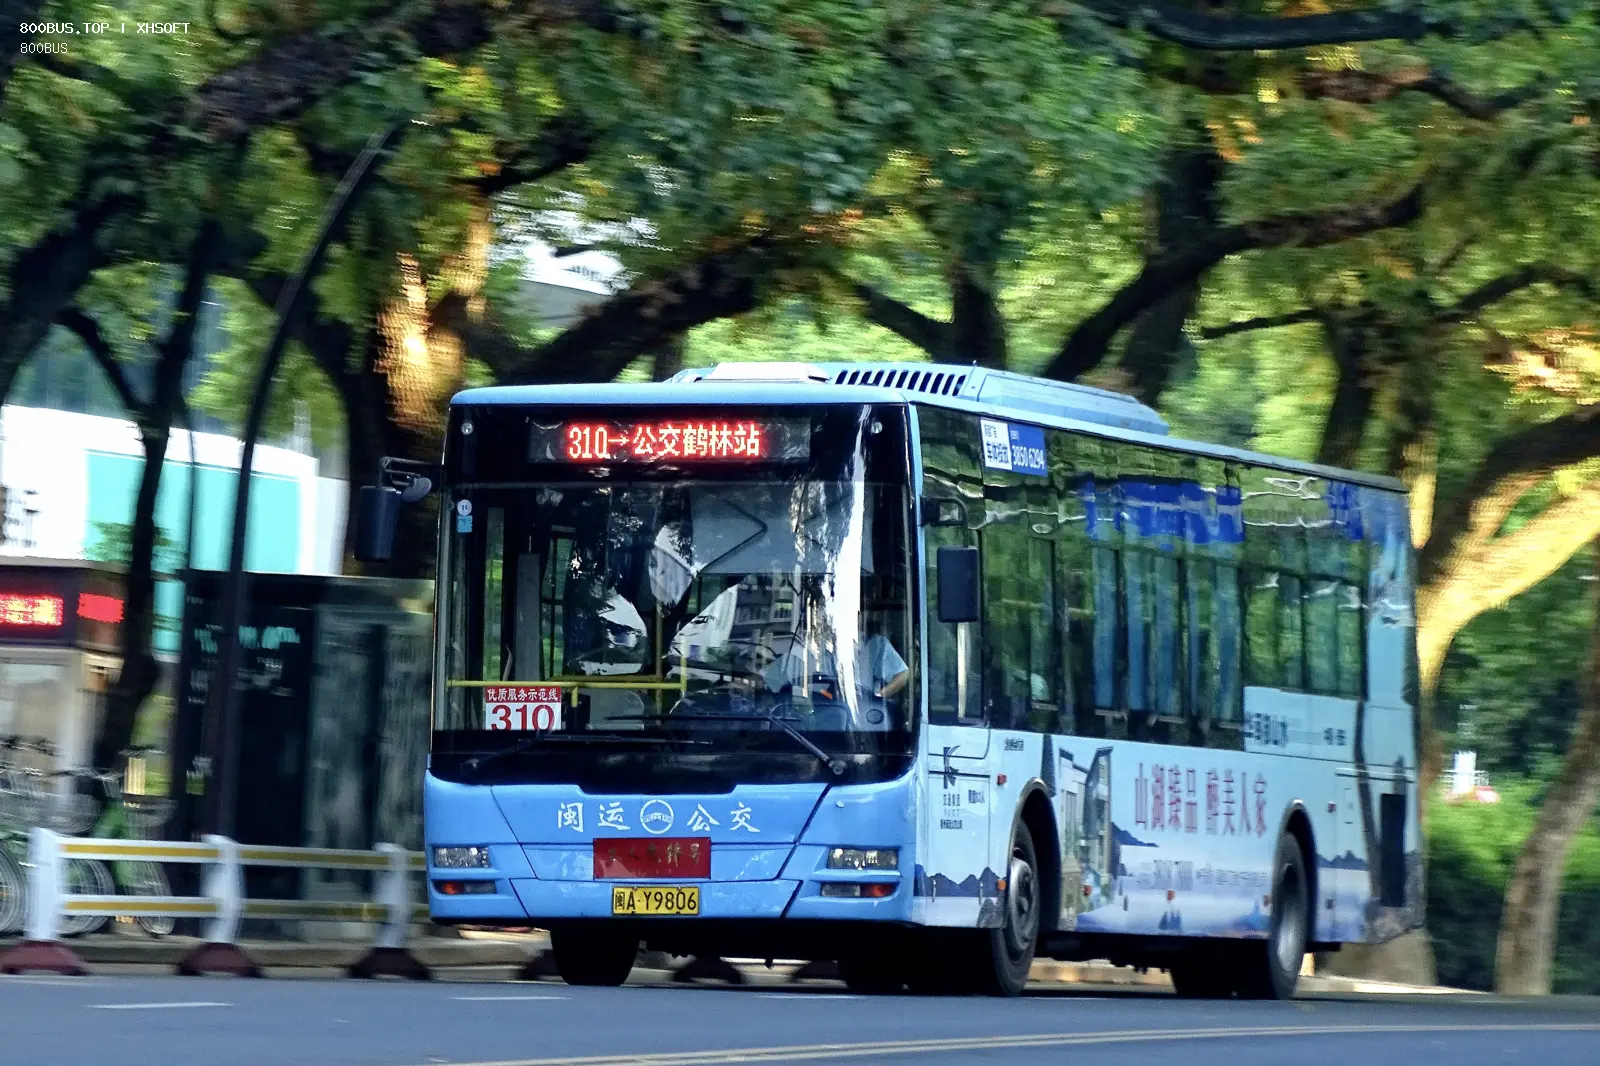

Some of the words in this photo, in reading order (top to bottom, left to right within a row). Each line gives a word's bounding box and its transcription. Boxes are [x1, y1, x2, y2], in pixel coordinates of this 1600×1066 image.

[568, 426, 610, 459] 310
[633, 424, 761, 456] 公交鹤林站
[487, 687, 559, 702] 优质服务示范线
[491, 704, 556, 731] 310
[557, 801, 632, 833] 闽运
[686, 801, 761, 833] 公交
